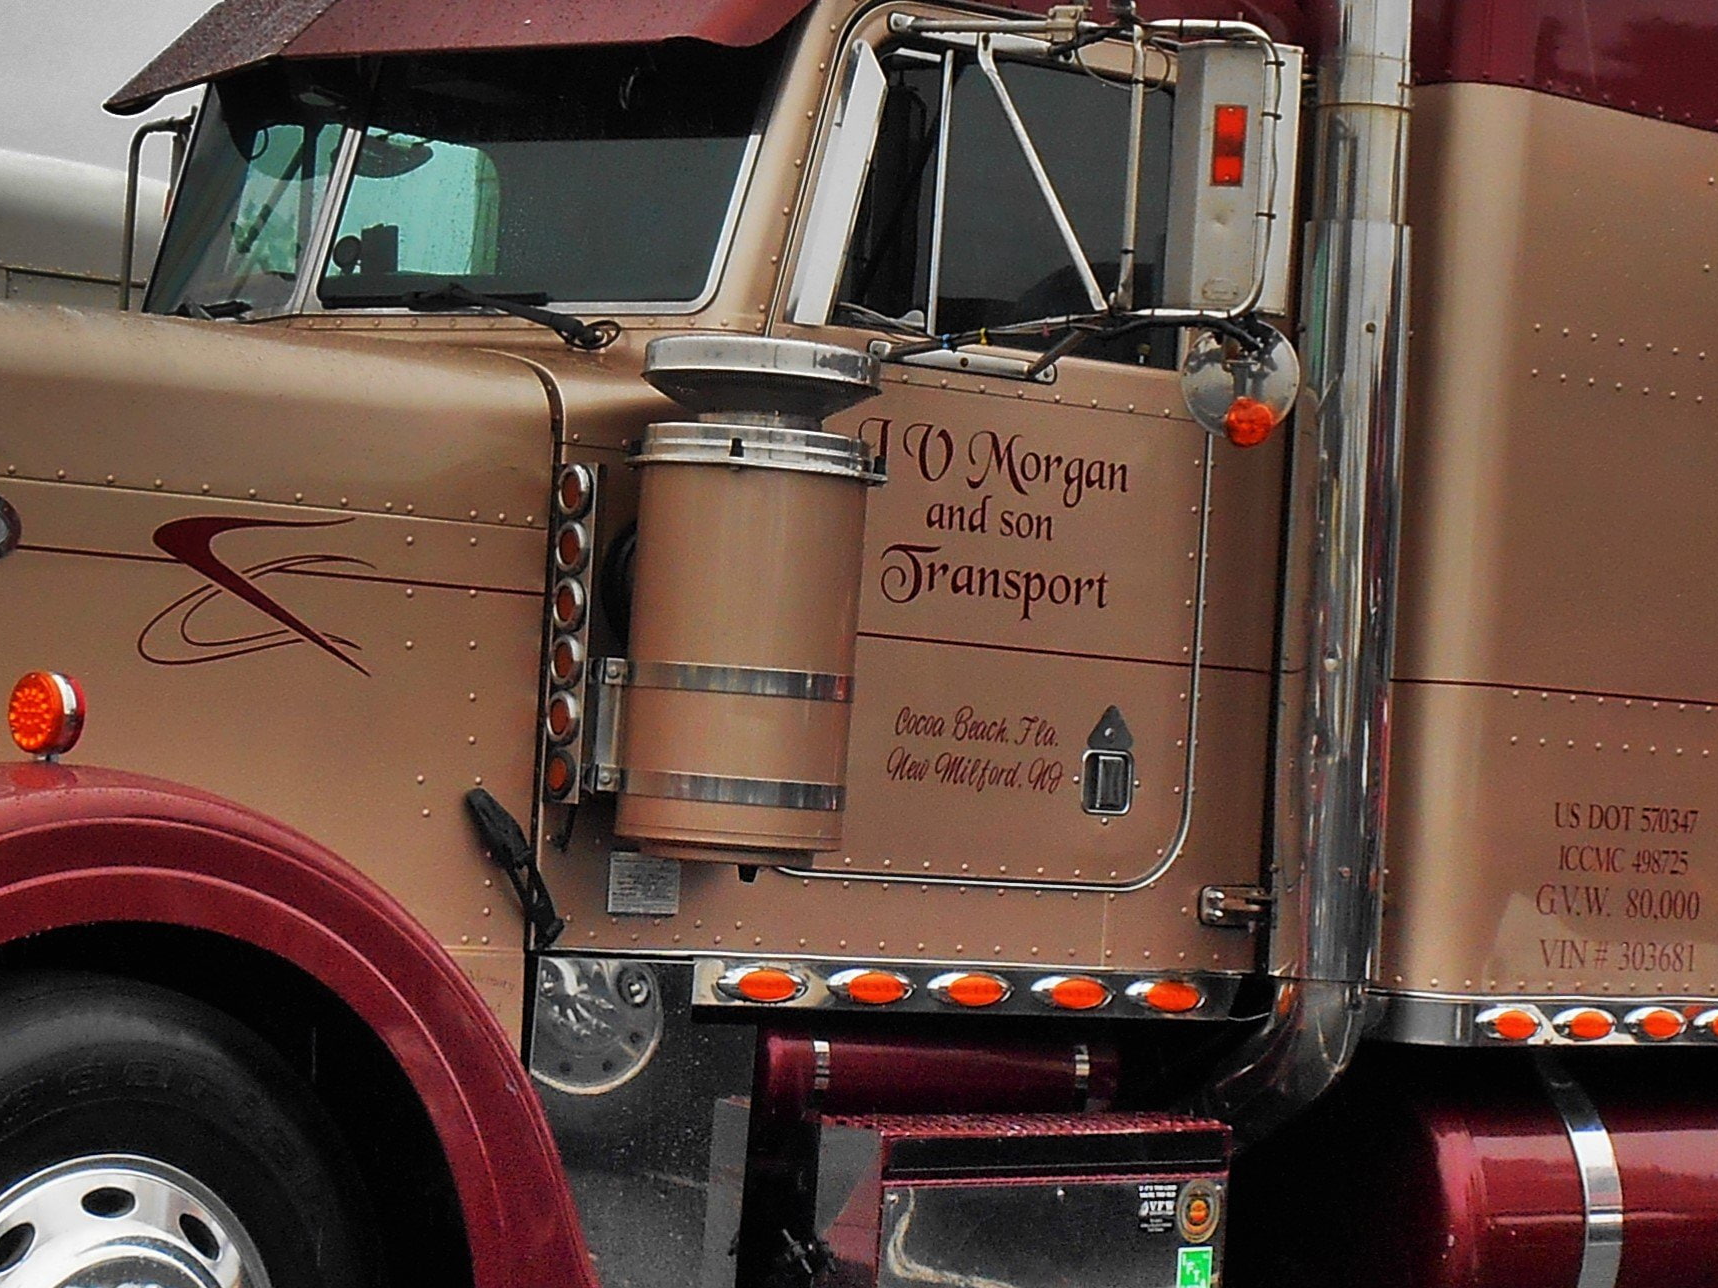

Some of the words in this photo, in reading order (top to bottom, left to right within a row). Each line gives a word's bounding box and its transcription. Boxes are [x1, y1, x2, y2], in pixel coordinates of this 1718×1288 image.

[966, 430, 1129, 509] Morgan
[926, 495, 993, 535] and
[999, 509, 1053, 541] son
[880, 543, 1110, 621] Transport
[895, 706, 945, 738] Cocoa
[886, 746, 929, 782] New
[1027, 757, 1064, 794] NJ
[1554, 802, 1581, 829] US
[1588, 803, 1634, 832] DOT
[1640, 807, 1699, 834] 570347
[1631, 849, 1689, 876] 498725
[1539, 938, 1587, 969] VIN
[1593, 940, 1609, 970] #
[1617, 941, 1695, 973] 303681
